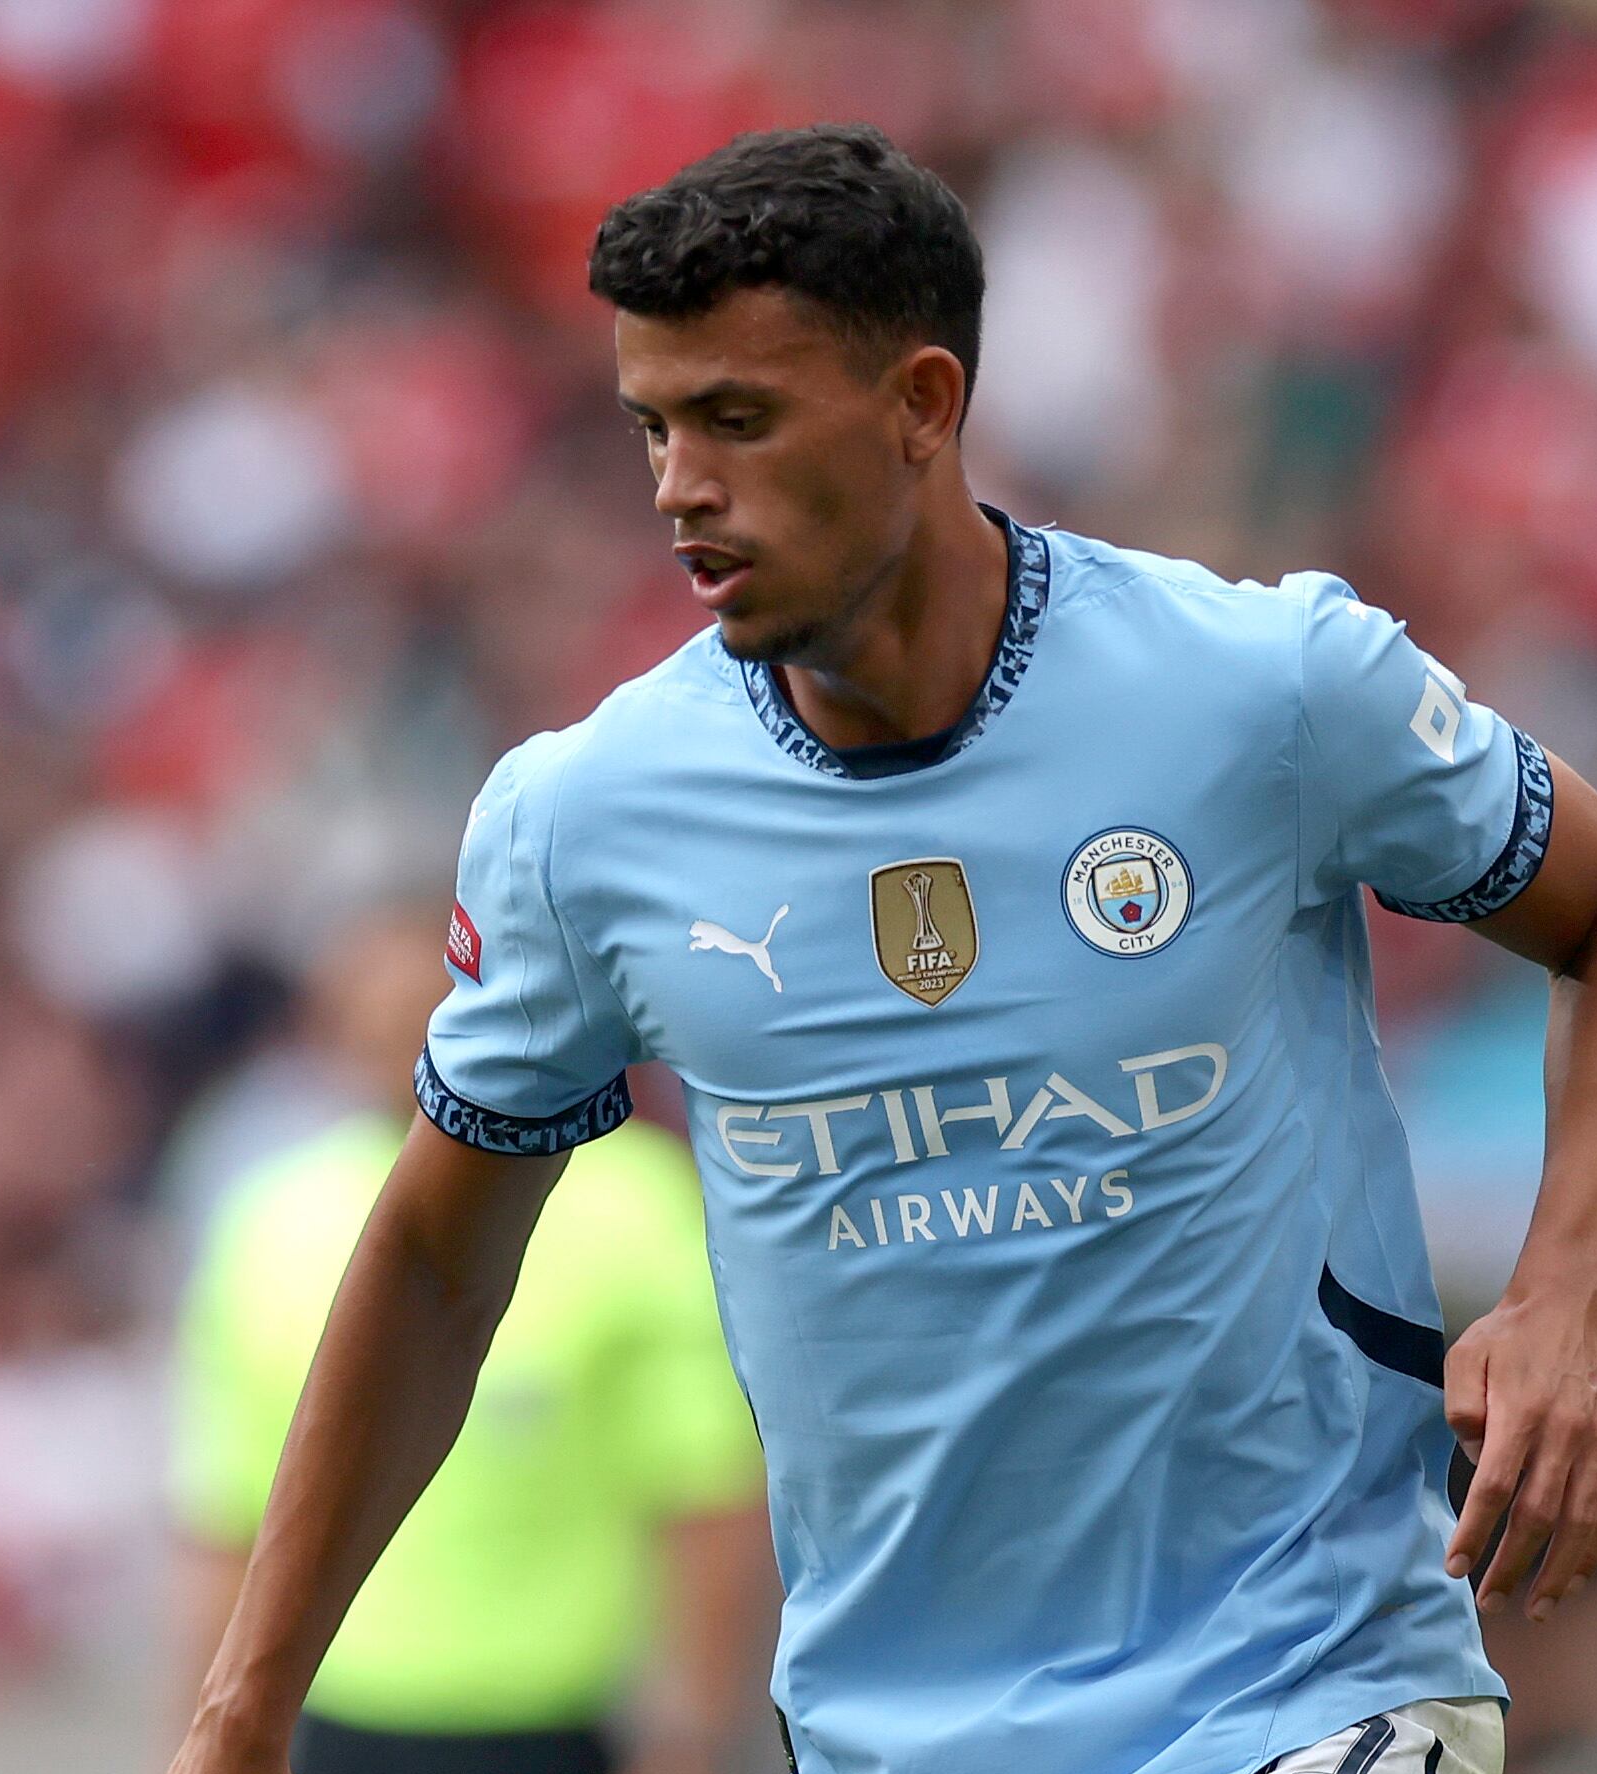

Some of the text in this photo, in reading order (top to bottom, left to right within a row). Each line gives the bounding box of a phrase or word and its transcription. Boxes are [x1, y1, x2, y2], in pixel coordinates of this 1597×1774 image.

[1073, 836, 1174, 884] MANCHESTER
[460, 926, 472, 952] FA
[1119, 933, 1155, 950] CITY
[907, 951, 953, 972] FIFA
[919, 978, 945, 990] 2023
[717, 1042, 1228, 1177] ETIHAD
[828, 1169, 1135, 1250] AIRWAYS
